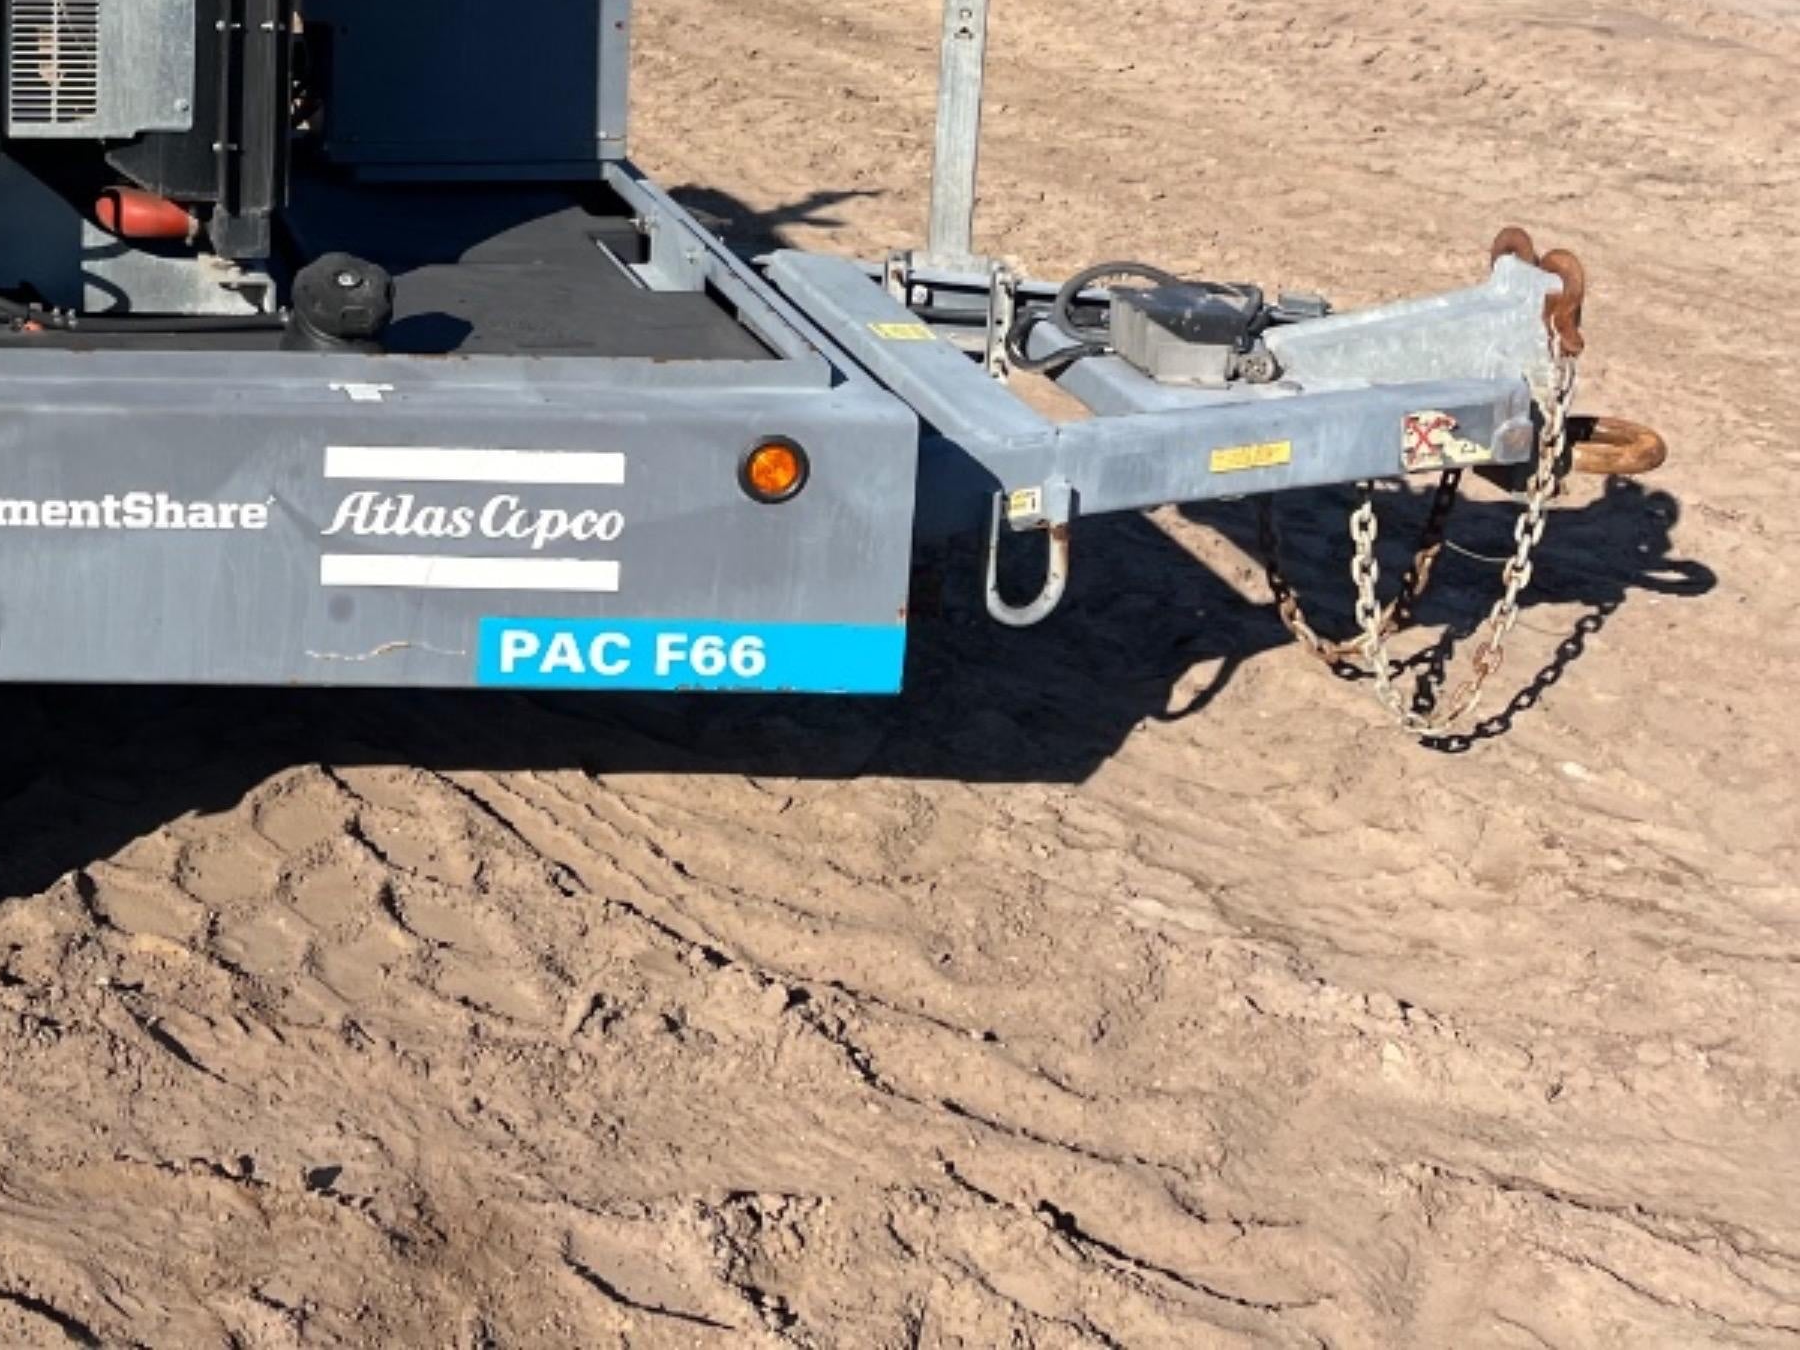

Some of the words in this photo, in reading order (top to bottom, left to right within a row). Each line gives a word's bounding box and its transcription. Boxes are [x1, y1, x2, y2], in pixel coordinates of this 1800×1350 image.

[320, 490, 475, 538] Atlas
[479, 493, 626, 550] Copco
[499, 628, 631, 676] PAC
[654, 632, 767, 678] F66
